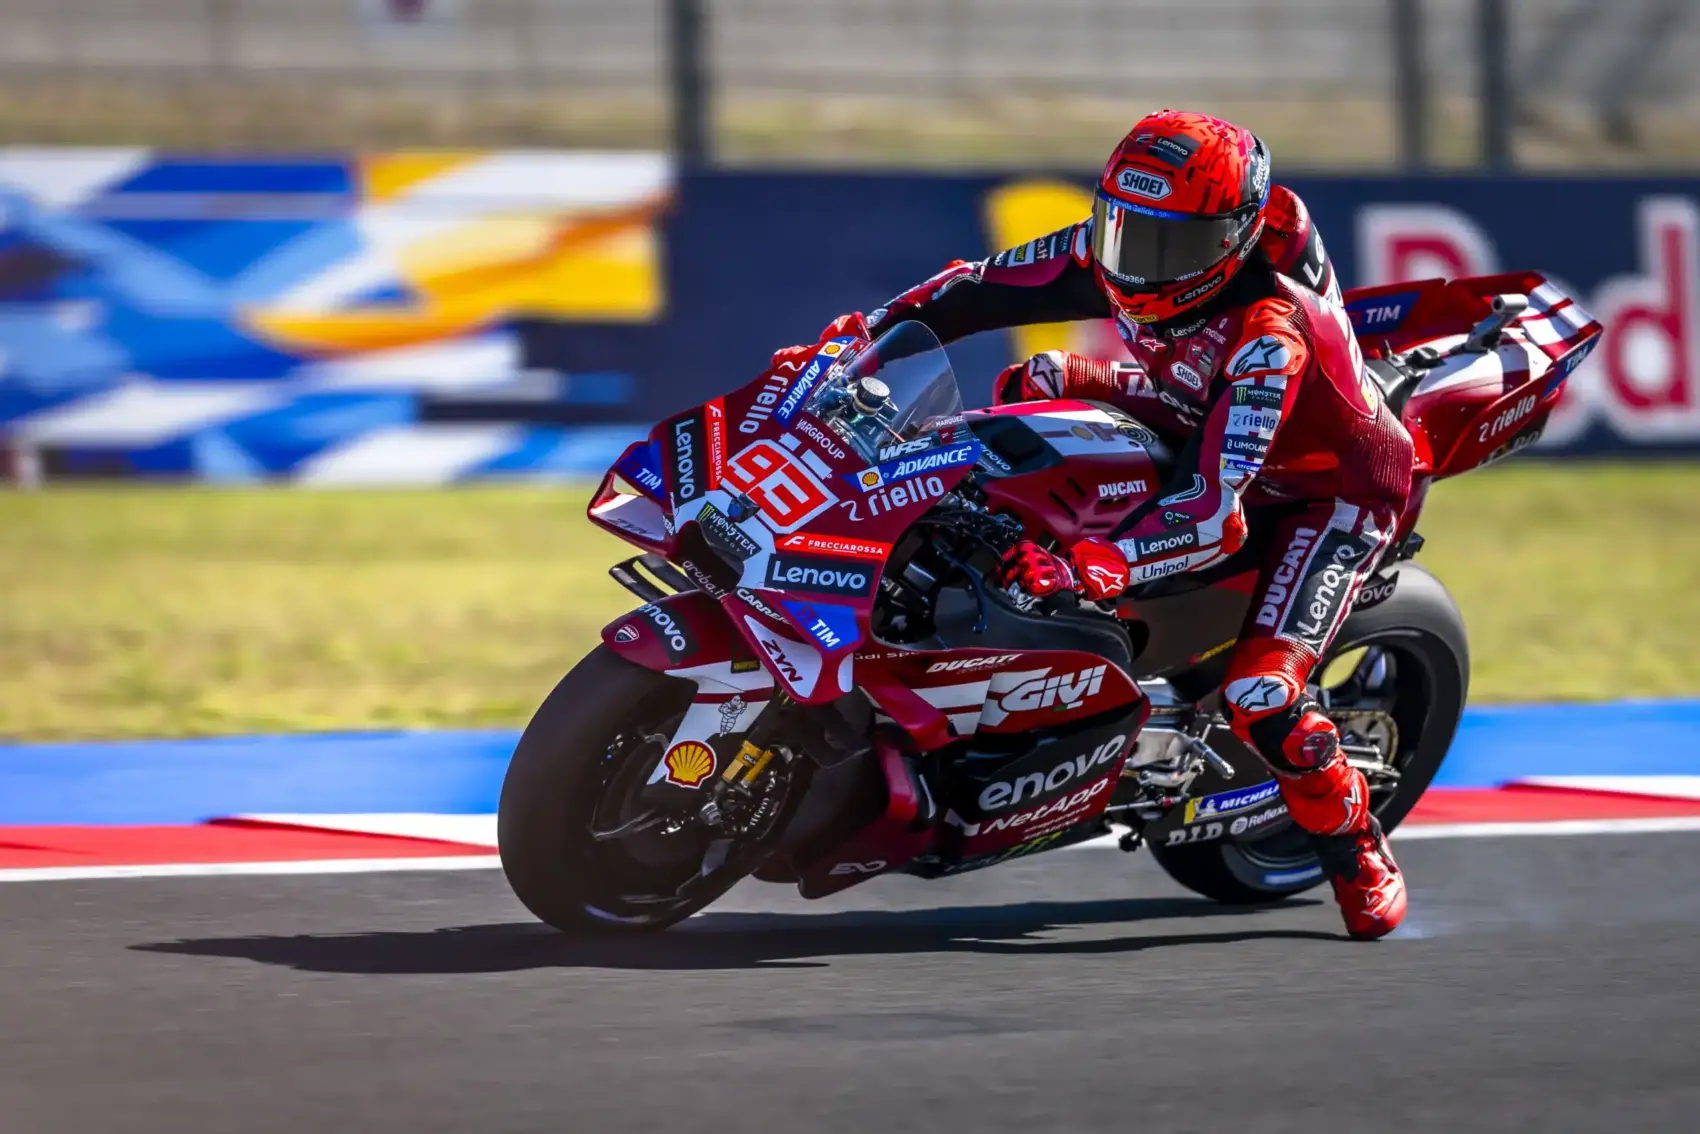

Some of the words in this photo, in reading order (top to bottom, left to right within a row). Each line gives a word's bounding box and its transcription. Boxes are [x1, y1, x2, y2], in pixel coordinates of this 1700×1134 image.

[1157, 137, 1188, 156] Lenovo
[1121, 171, 1163, 195] SHOEI
[1175, 270, 1204, 282] VERTICAL
[1177, 276, 1222, 303] Lenovo
[1171, 318, 1206, 337] Lenovo
[1365, 305, 1401, 324] TIM
[778, 360, 820, 419] ADVANCE
[1177, 366, 1199, 386] SHOEI
[739, 374, 789, 434] riello
[1491, 394, 1536, 436] riello
[1243, 414, 1276, 430] riello
[675, 418, 695, 499] Lenovo
[713, 421, 722, 480] FRECCIAROSSA
[880, 436, 932, 461] WRS
[892, 448, 968, 478] ADVANCE
[636, 467, 662, 491] TIM
[722, 441, 832, 530] 93
[1098, 479, 1147, 497] DUCATI
[868, 476, 945, 516] riello
[710, 512, 757, 555] MONSTER
[808, 540, 883, 554] FRECCIAROSSA
[1140, 533, 1194, 555] Lenovo
[772, 560, 866, 589] Lenovo
[1137, 556, 1189, 582] Unipol
[1256, 527, 1319, 627] DUCATI
[1297, 544, 1355, 637] Lenovo
[810, 619, 840, 648] TIM
[762, 639, 803, 683] ZYN
[926, 653, 1023, 674] DUCATI
[1001, 664, 1107, 712] GIVI
[983, 777, 1108, 835] NetApp
